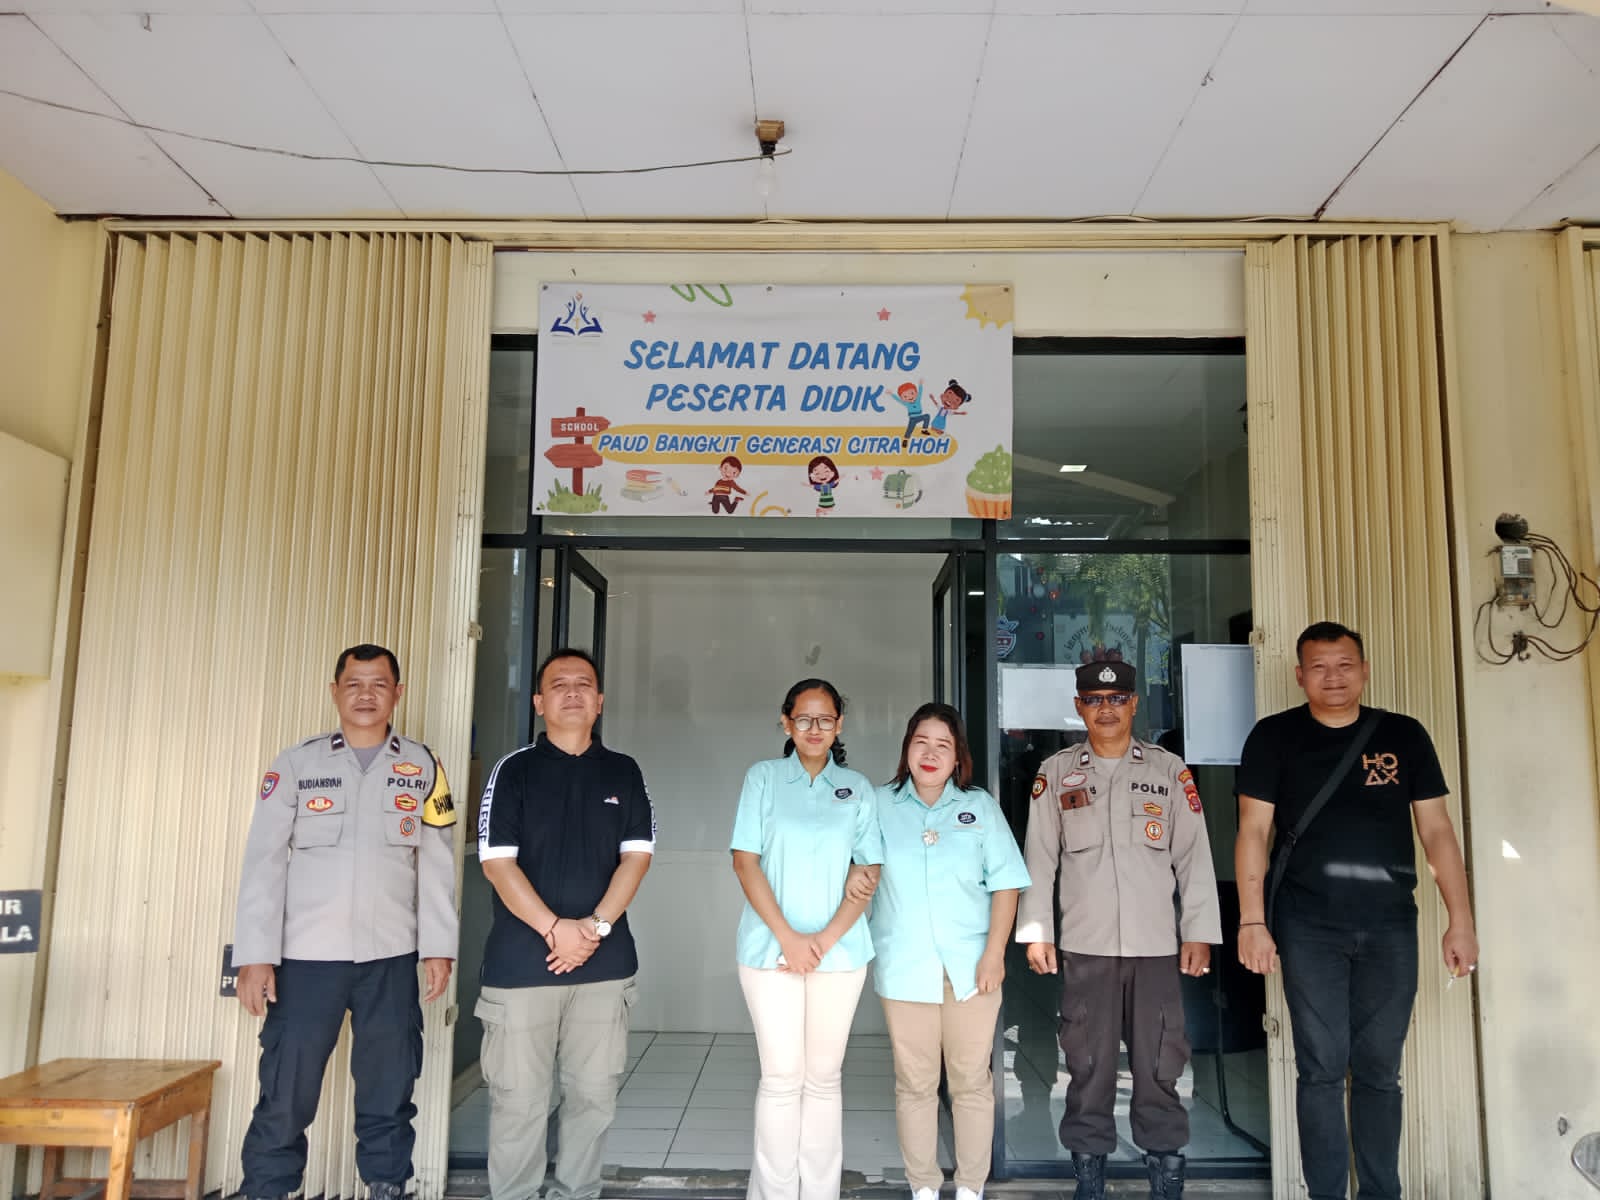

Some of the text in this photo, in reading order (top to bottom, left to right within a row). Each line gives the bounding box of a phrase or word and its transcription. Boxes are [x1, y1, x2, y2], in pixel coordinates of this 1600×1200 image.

[623, 340, 921, 371] SELAMAT DATANG
[645, 383, 886, 413] PESERTA DIDIK
[560, 422, 600, 432] SCHOOL
[598, 434, 951, 455] PAUD BANGKIT GENERASI CITRA HOH
[387, 777, 427, 791] POLRI
[1131, 782, 1169, 797] POLRI
